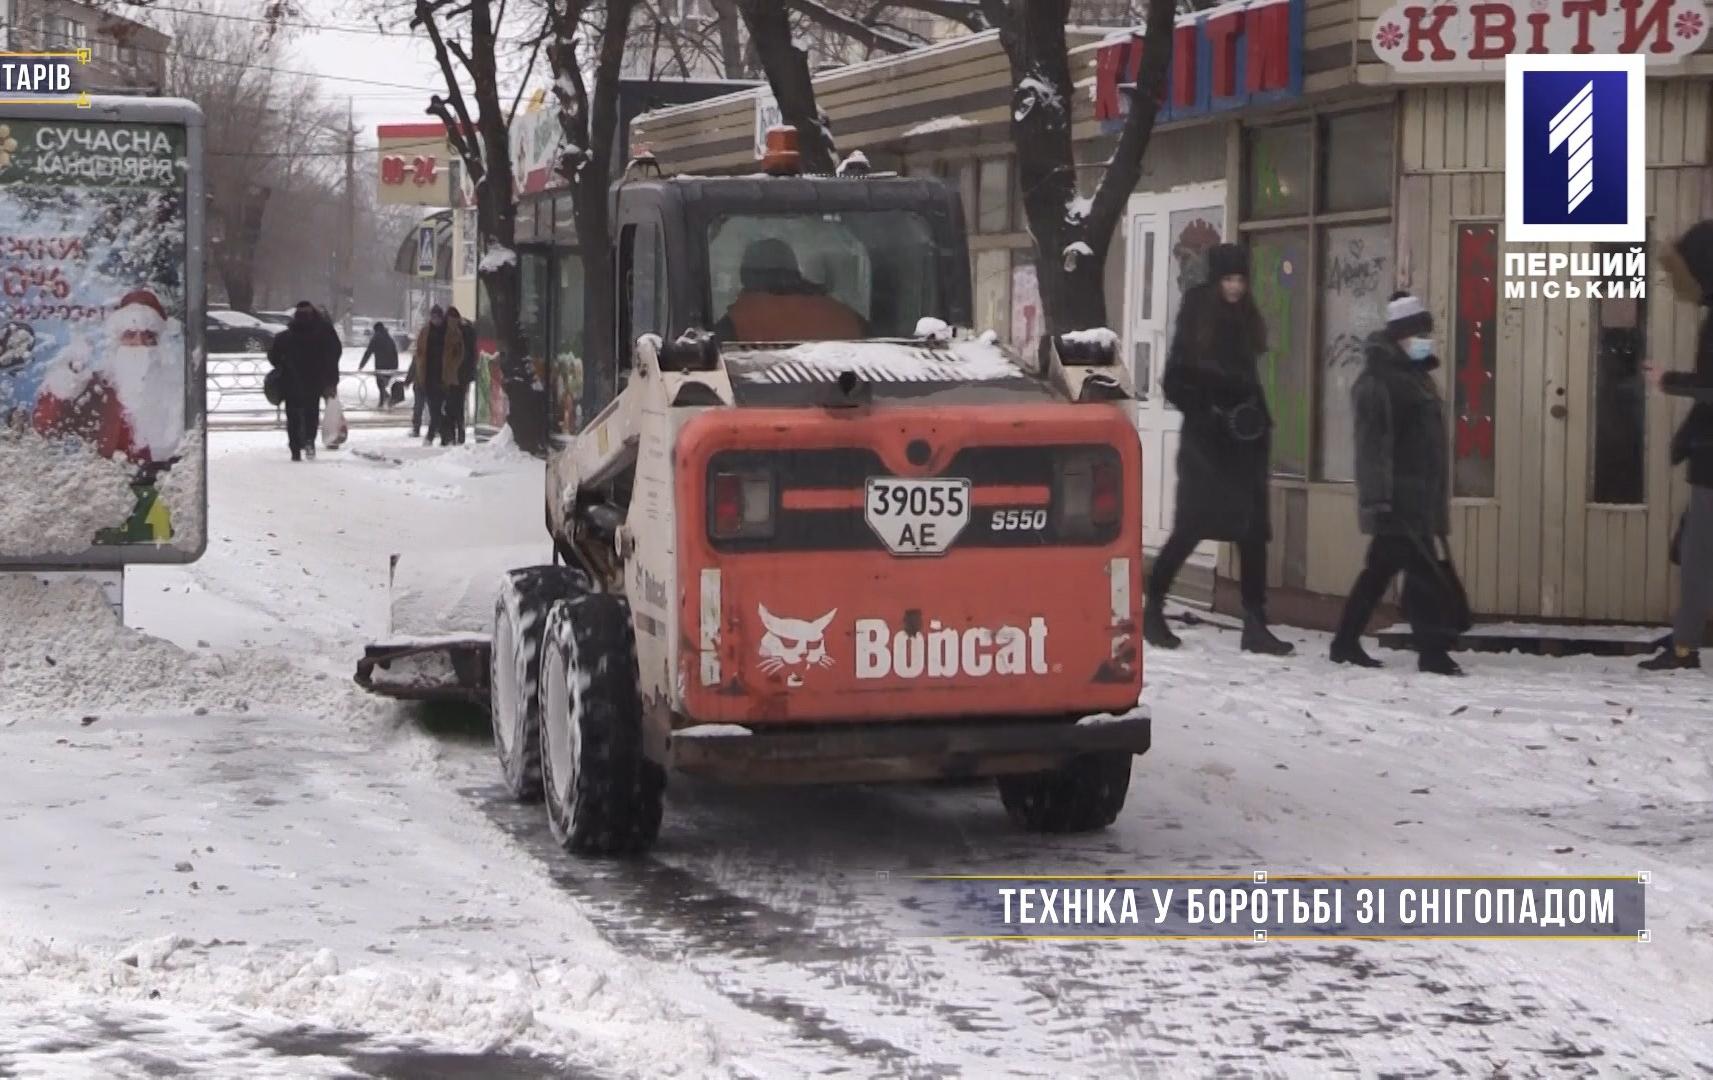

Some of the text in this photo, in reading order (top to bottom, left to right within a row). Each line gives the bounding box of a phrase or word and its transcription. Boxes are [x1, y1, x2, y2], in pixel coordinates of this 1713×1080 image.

[1095, 2, 1291, 121] КІТИ
[36, 127, 172, 153] СУЧАСНА
[873, 485, 963, 516] 39055
[991, 510, 1047, 530] S550
[898, 523, 937, 546] AE
[856, 617, 1048, 678] Bobcat
